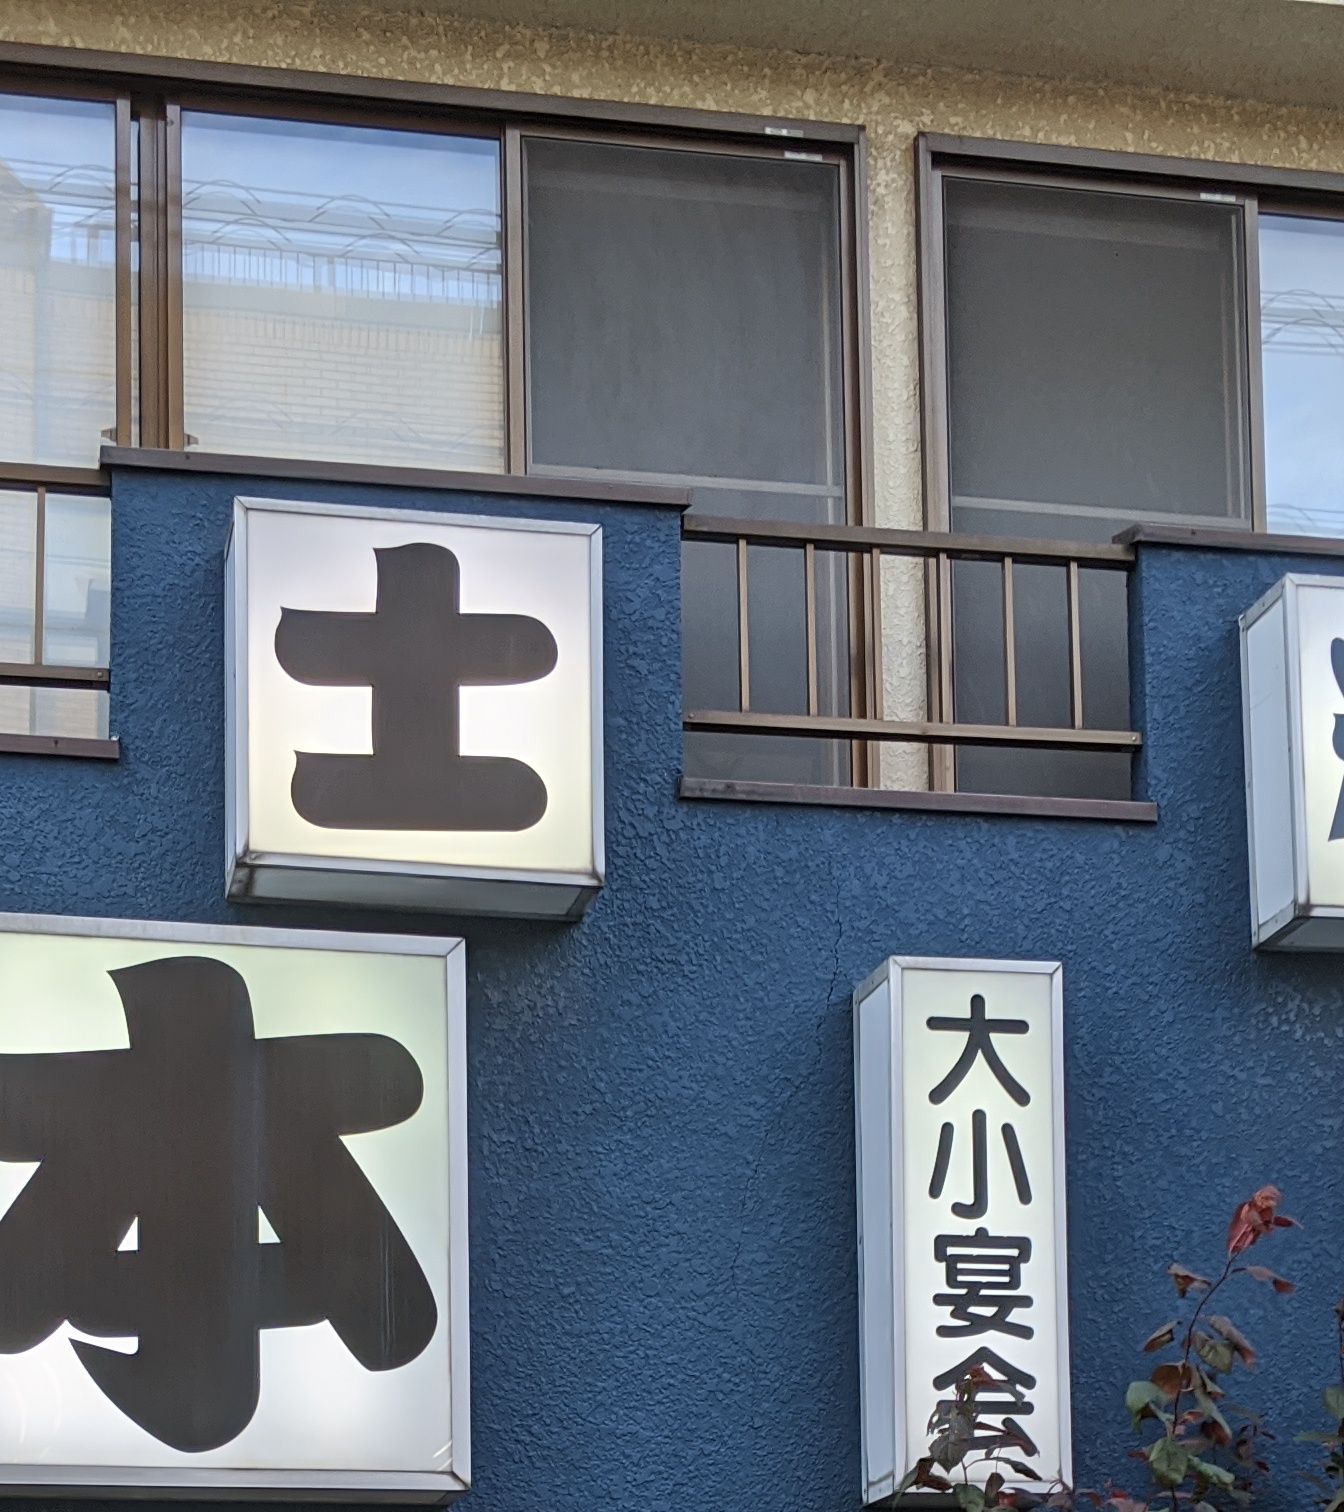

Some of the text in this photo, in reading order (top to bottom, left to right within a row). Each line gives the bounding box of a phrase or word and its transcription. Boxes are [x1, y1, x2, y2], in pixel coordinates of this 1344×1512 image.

[274, 542, 558, 832] 士
[926, 994, 1040, 1456] 大小宴会
